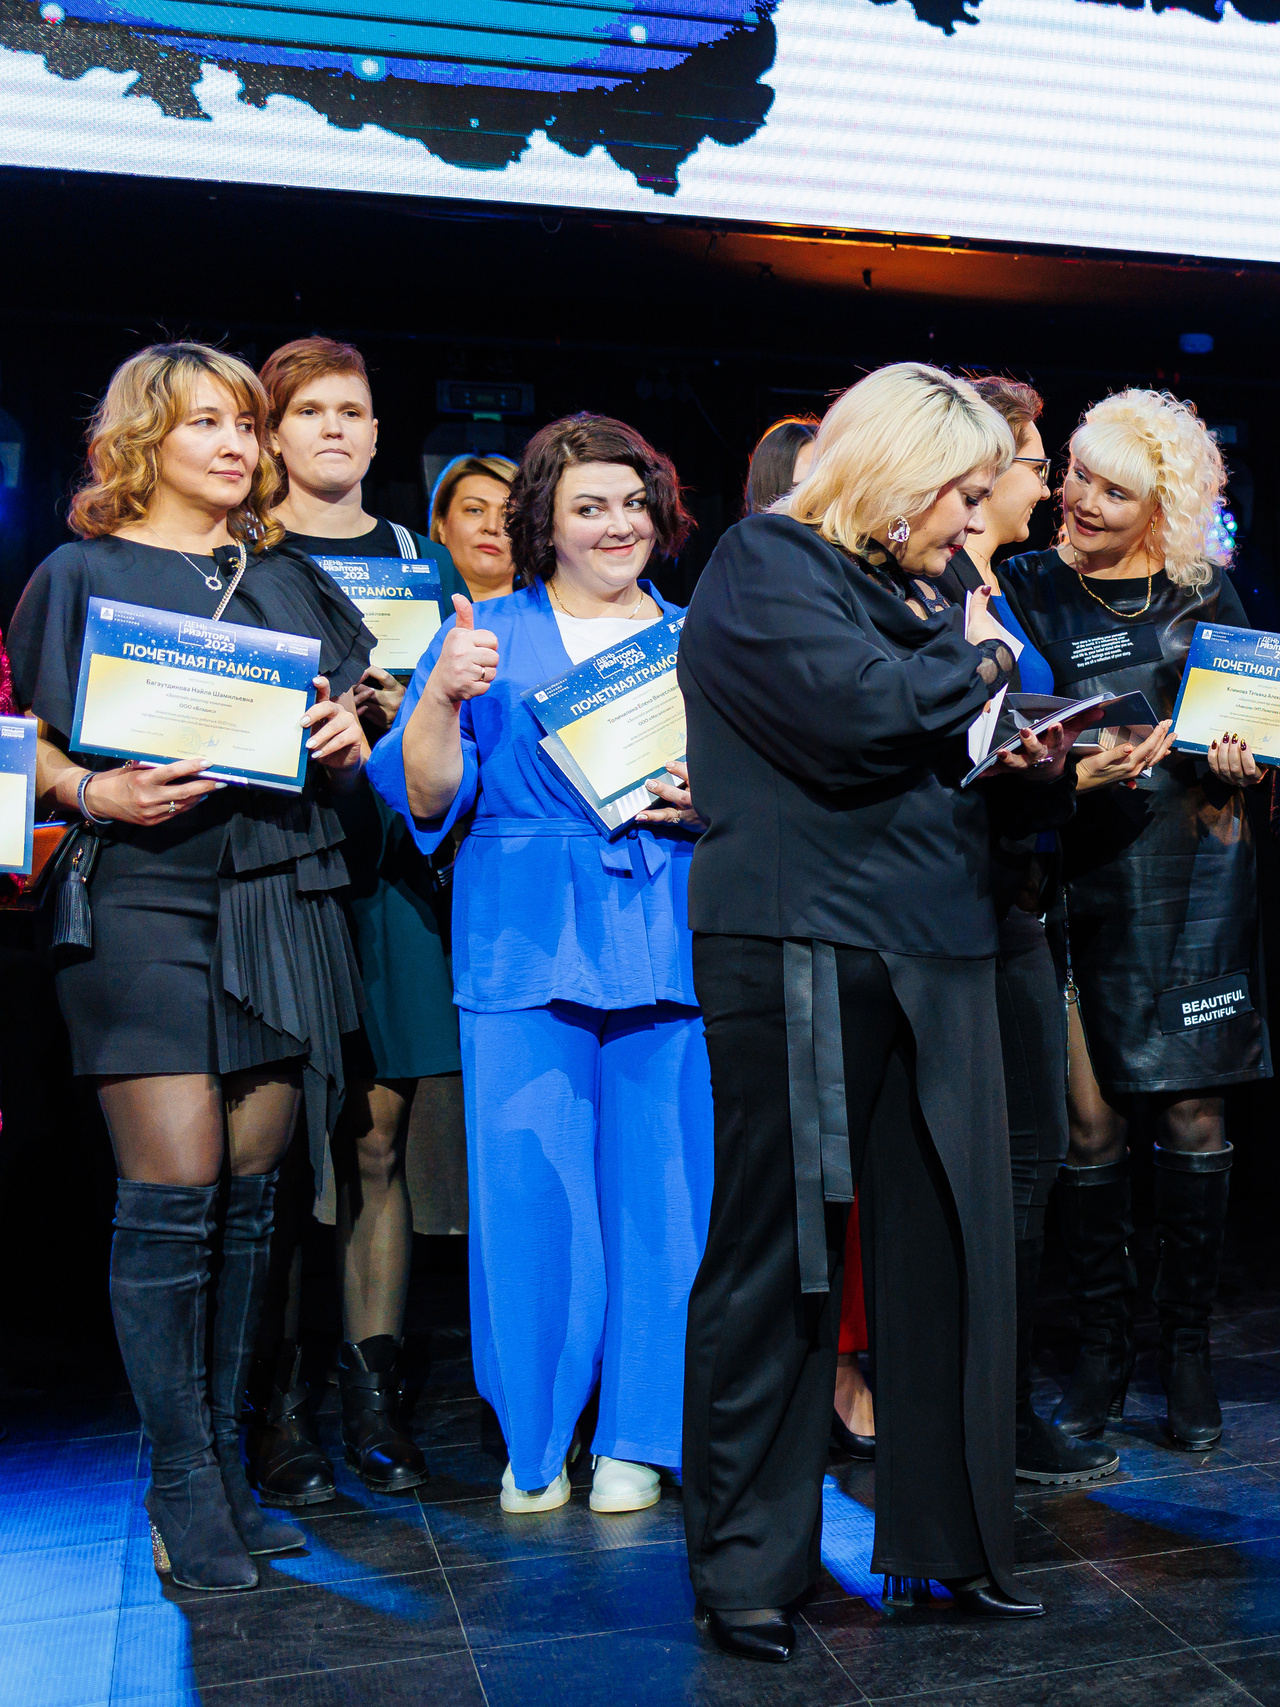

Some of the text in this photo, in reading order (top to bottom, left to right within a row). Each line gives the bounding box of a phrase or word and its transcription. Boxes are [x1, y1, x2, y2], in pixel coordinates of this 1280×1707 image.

[343, 572, 370, 580] 2023
[352, 587, 413, 597] ГРАМОТА
[184, 620, 208, 631] ДЕНЬ
[183, 628, 230, 642] РИЭЛТОРА
[1262, 636, 1280, 644] ДЕНЬ
[204, 639, 235, 653] 2023
[122, 643, 281, 683] ПОЧЕТНАЯ ГРАМОТА
[595, 653, 615, 665] ДЕНЬ
[598, 648, 637, 671] РИЭЛТОРА
[620, 651, 646, 670] 2023
[1213, 657, 1273, 677] ПОЧЕТНАЯ
[146, 679, 190, 693] Багаутдинова
[191, 687, 211, 696] Найля
[213, 691, 253, 703] Шамильевна
[570, 651, 678, 716] ПОЧЕТНАЯ ГРАМО
[637, 698, 653, 708] Елена
[1182, 989, 1245, 1014] BEAUTIFUL
[1184, 1005, 1236, 1026] BEAUTIFUL
